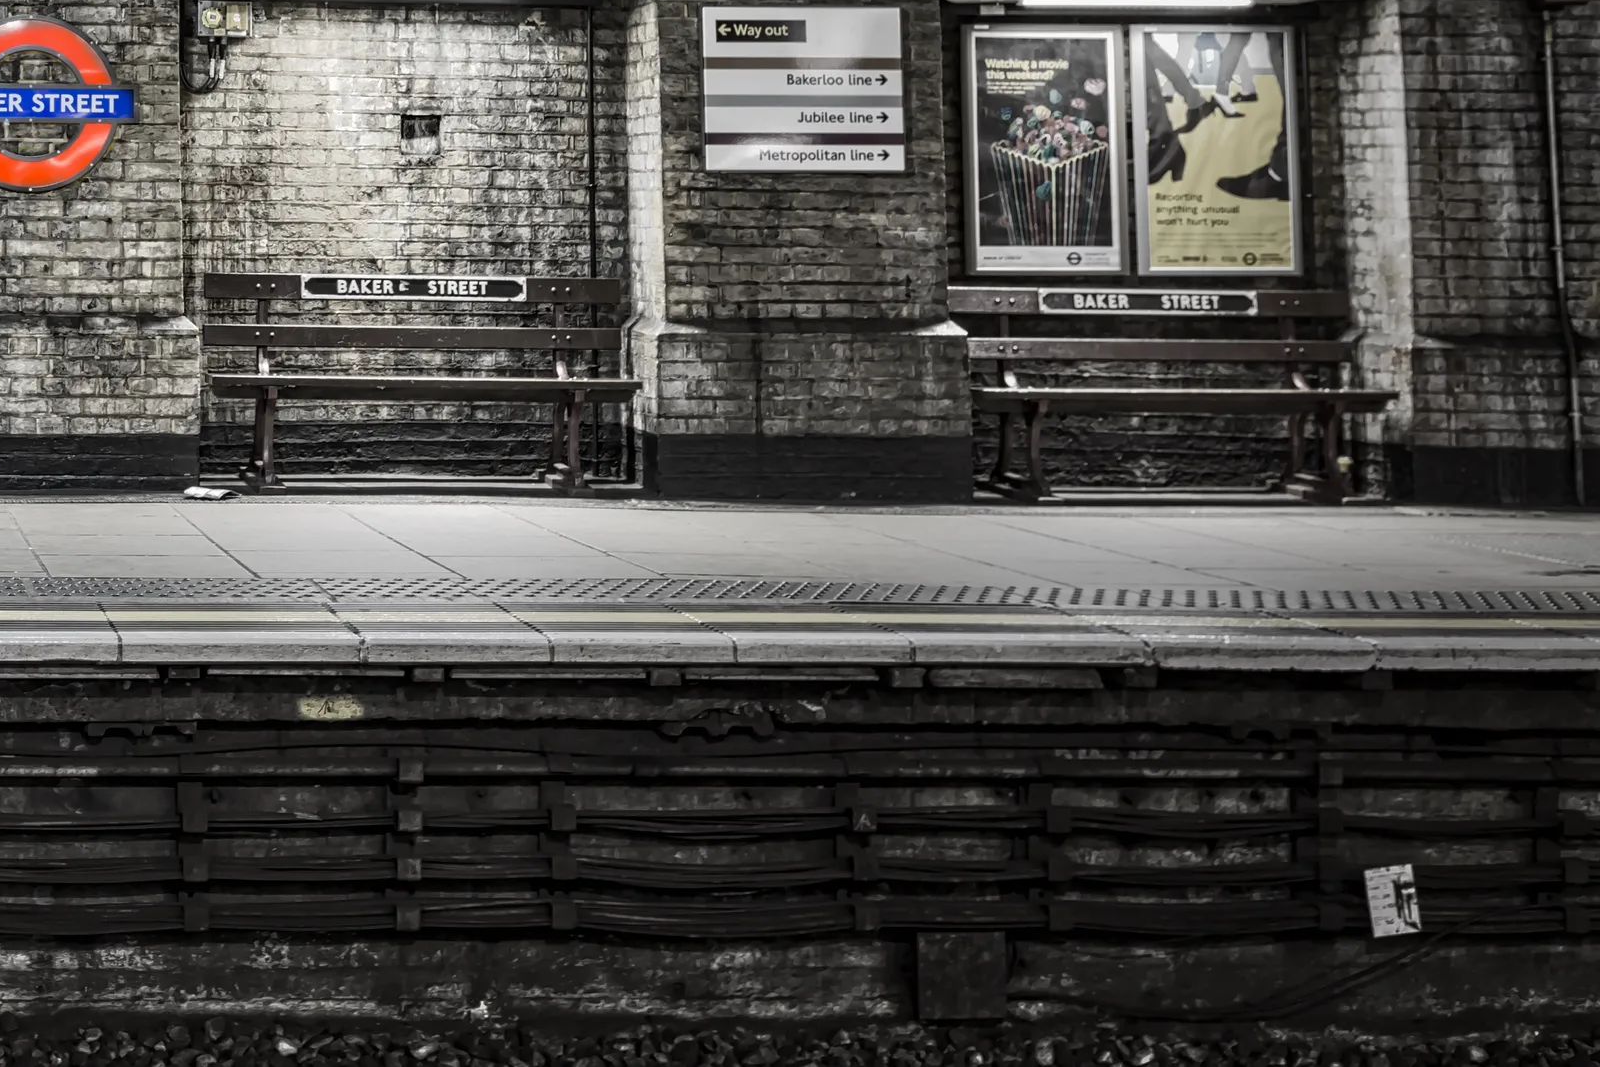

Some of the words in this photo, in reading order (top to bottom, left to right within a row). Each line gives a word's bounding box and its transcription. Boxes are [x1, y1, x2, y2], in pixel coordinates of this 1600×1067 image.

[733, 23, 762, 39] Way
[765, 25, 789, 37] out
[984, 57, 1030, 71] Watching
[1030, 60, 1037, 69] a
[1038, 58, 1070, 70] movie
[786, 73, 844, 86] Bakerloo
[848, 74, 873, 86] line
[985, 69, 1006, 80] this
[1006, 69, 1055, 81] weekend?
[31, 93, 120, 114] STREET
[797, 111, 845, 124] Jubilee
[849, 112, 874, 124] line
[759, 149, 846, 164] Metropolitan
[850, 149, 875, 161] line
[1155, 192, 1203, 203] Reporting
[336, 279, 394, 295] BAKER
[427, 280, 489, 296] STREET
[1073, 294, 1130, 310] BAKER
[1160, 294, 1220, 310] STREET
